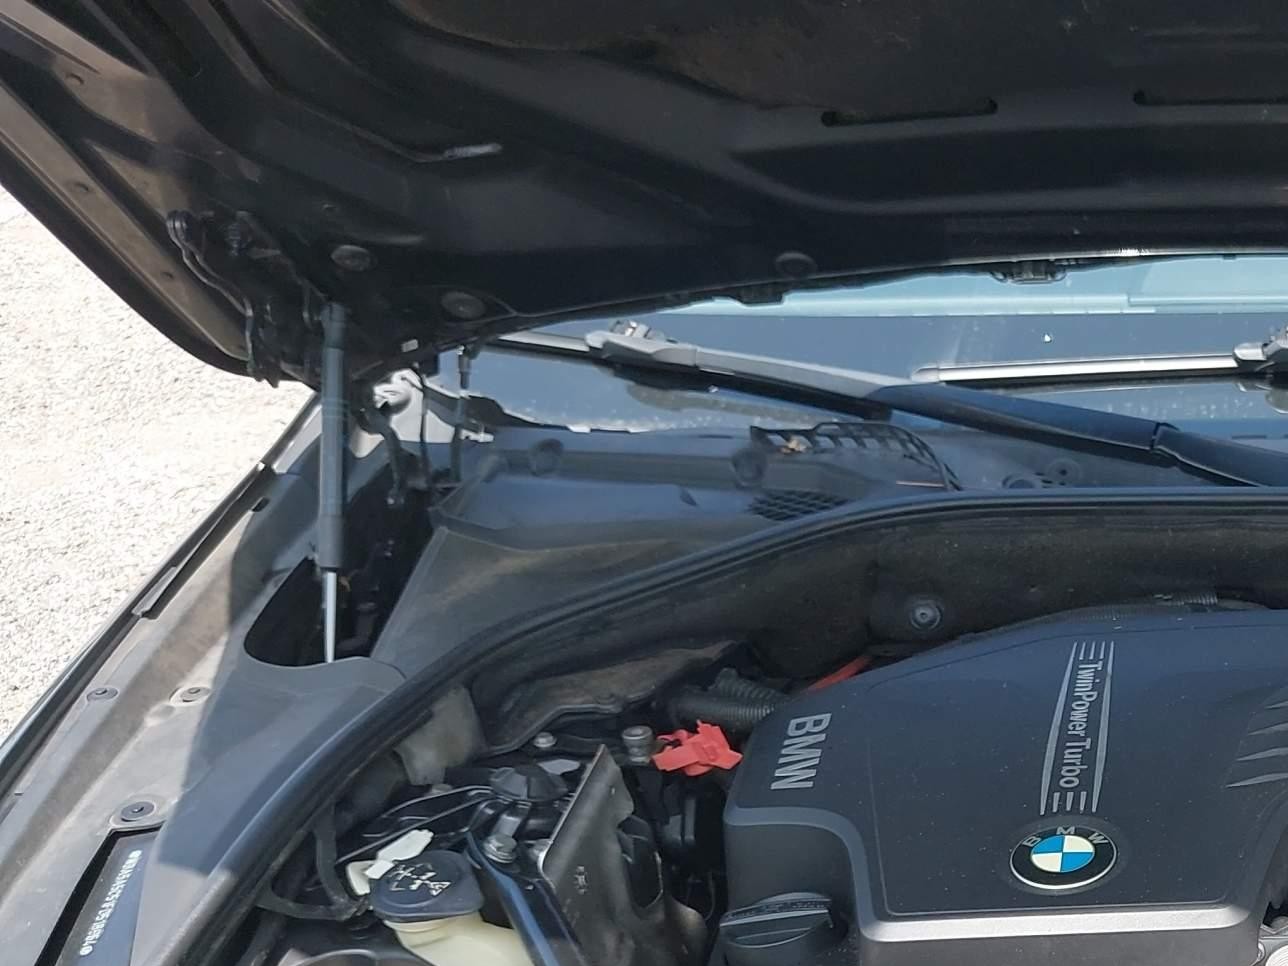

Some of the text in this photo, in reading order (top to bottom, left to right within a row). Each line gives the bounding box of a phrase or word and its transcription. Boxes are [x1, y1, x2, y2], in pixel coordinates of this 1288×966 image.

[770, 712, 832, 790] BMW
[1059, 659, 1102, 789] TwinPower Turbo
[1022, 825, 1109, 847] BMW
